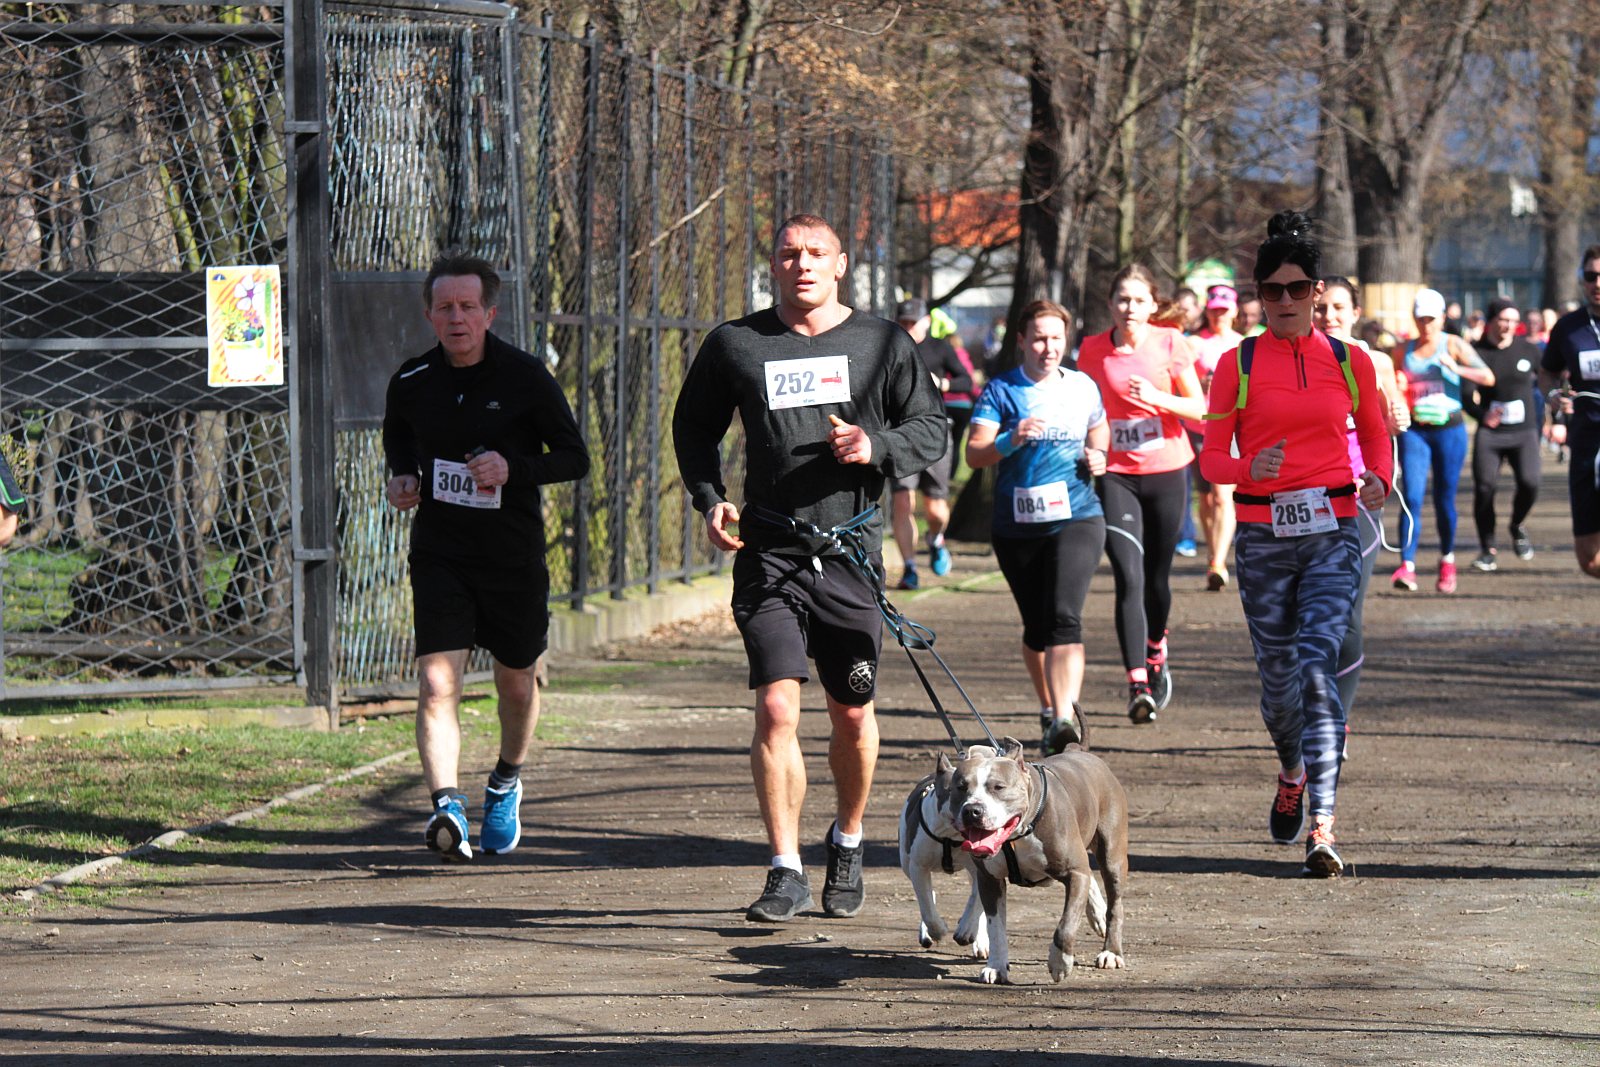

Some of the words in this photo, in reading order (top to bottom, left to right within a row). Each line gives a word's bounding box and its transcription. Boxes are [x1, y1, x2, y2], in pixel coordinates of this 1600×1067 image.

[773, 370, 816, 397] 252
[1114, 427, 1140, 444] 214
[438, 471, 474, 496] 304
[1016, 496, 1046, 514] 084
[1275, 502, 1312, 526] 285
